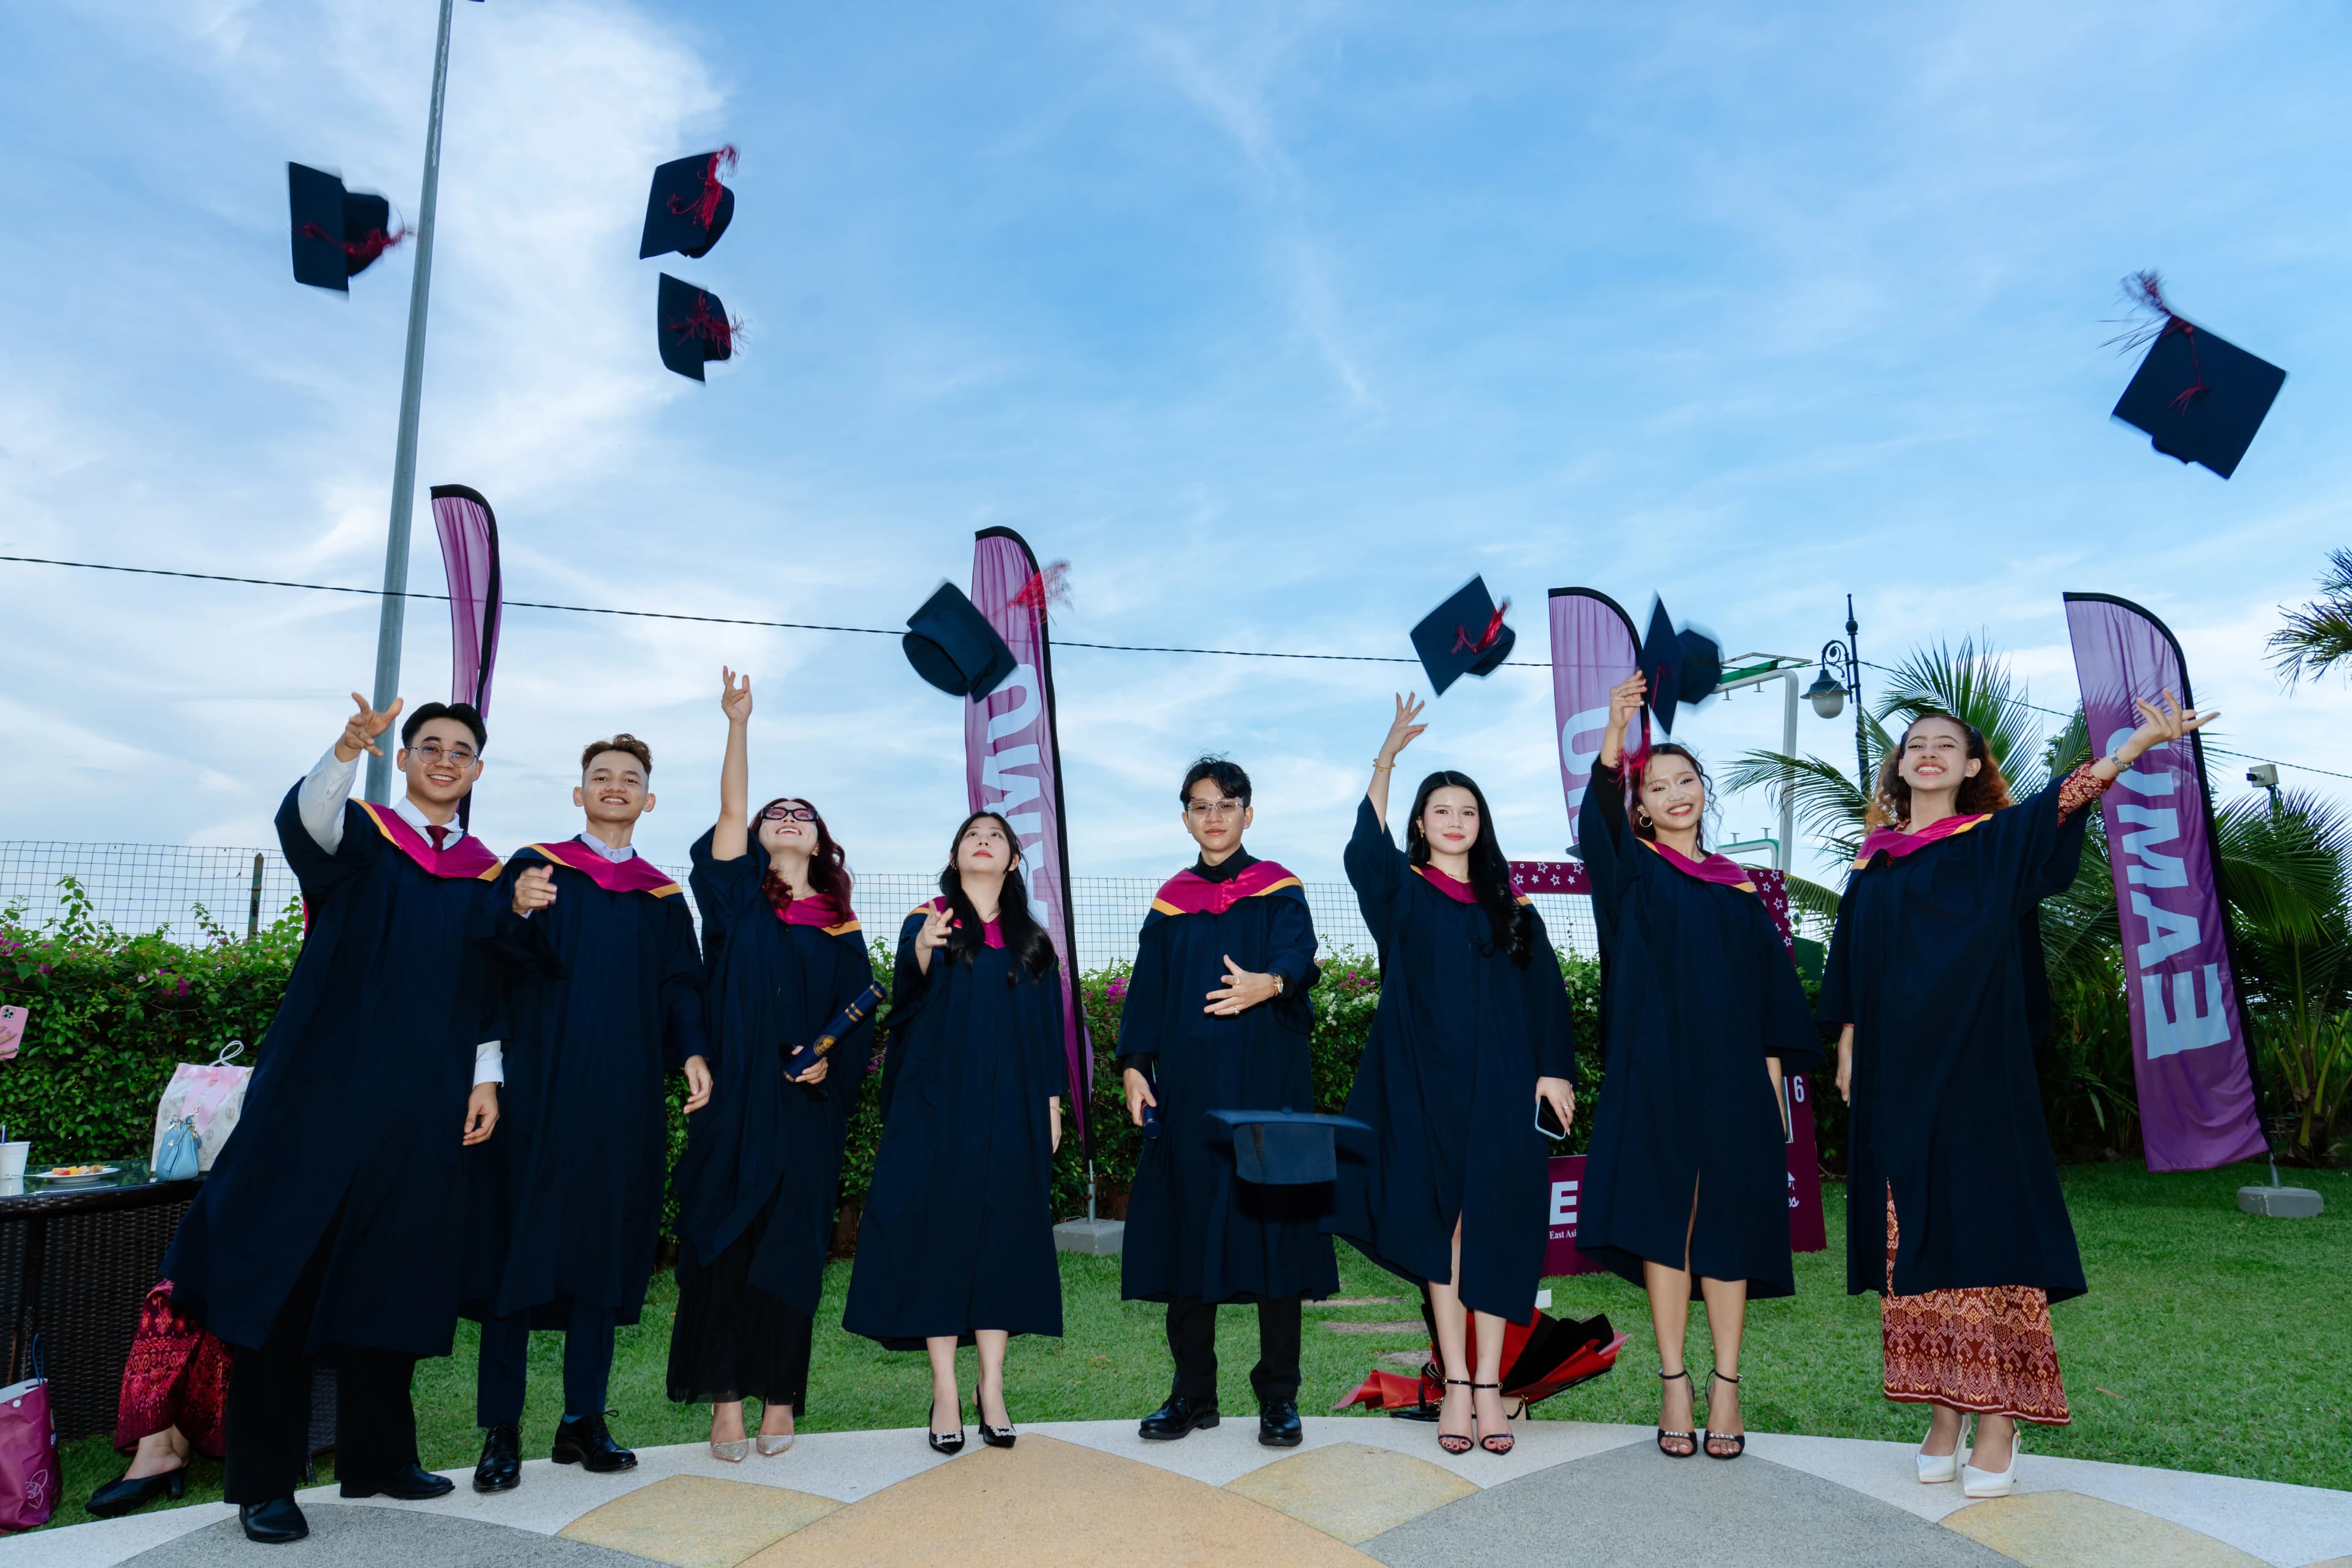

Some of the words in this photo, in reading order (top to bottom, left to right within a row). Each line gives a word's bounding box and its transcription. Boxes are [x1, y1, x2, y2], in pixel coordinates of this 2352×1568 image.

[1793, 1076, 1804, 1102] 6
[1549, 1230, 1564, 1239] East
[1566, 1229, 1577, 1238] Asi
